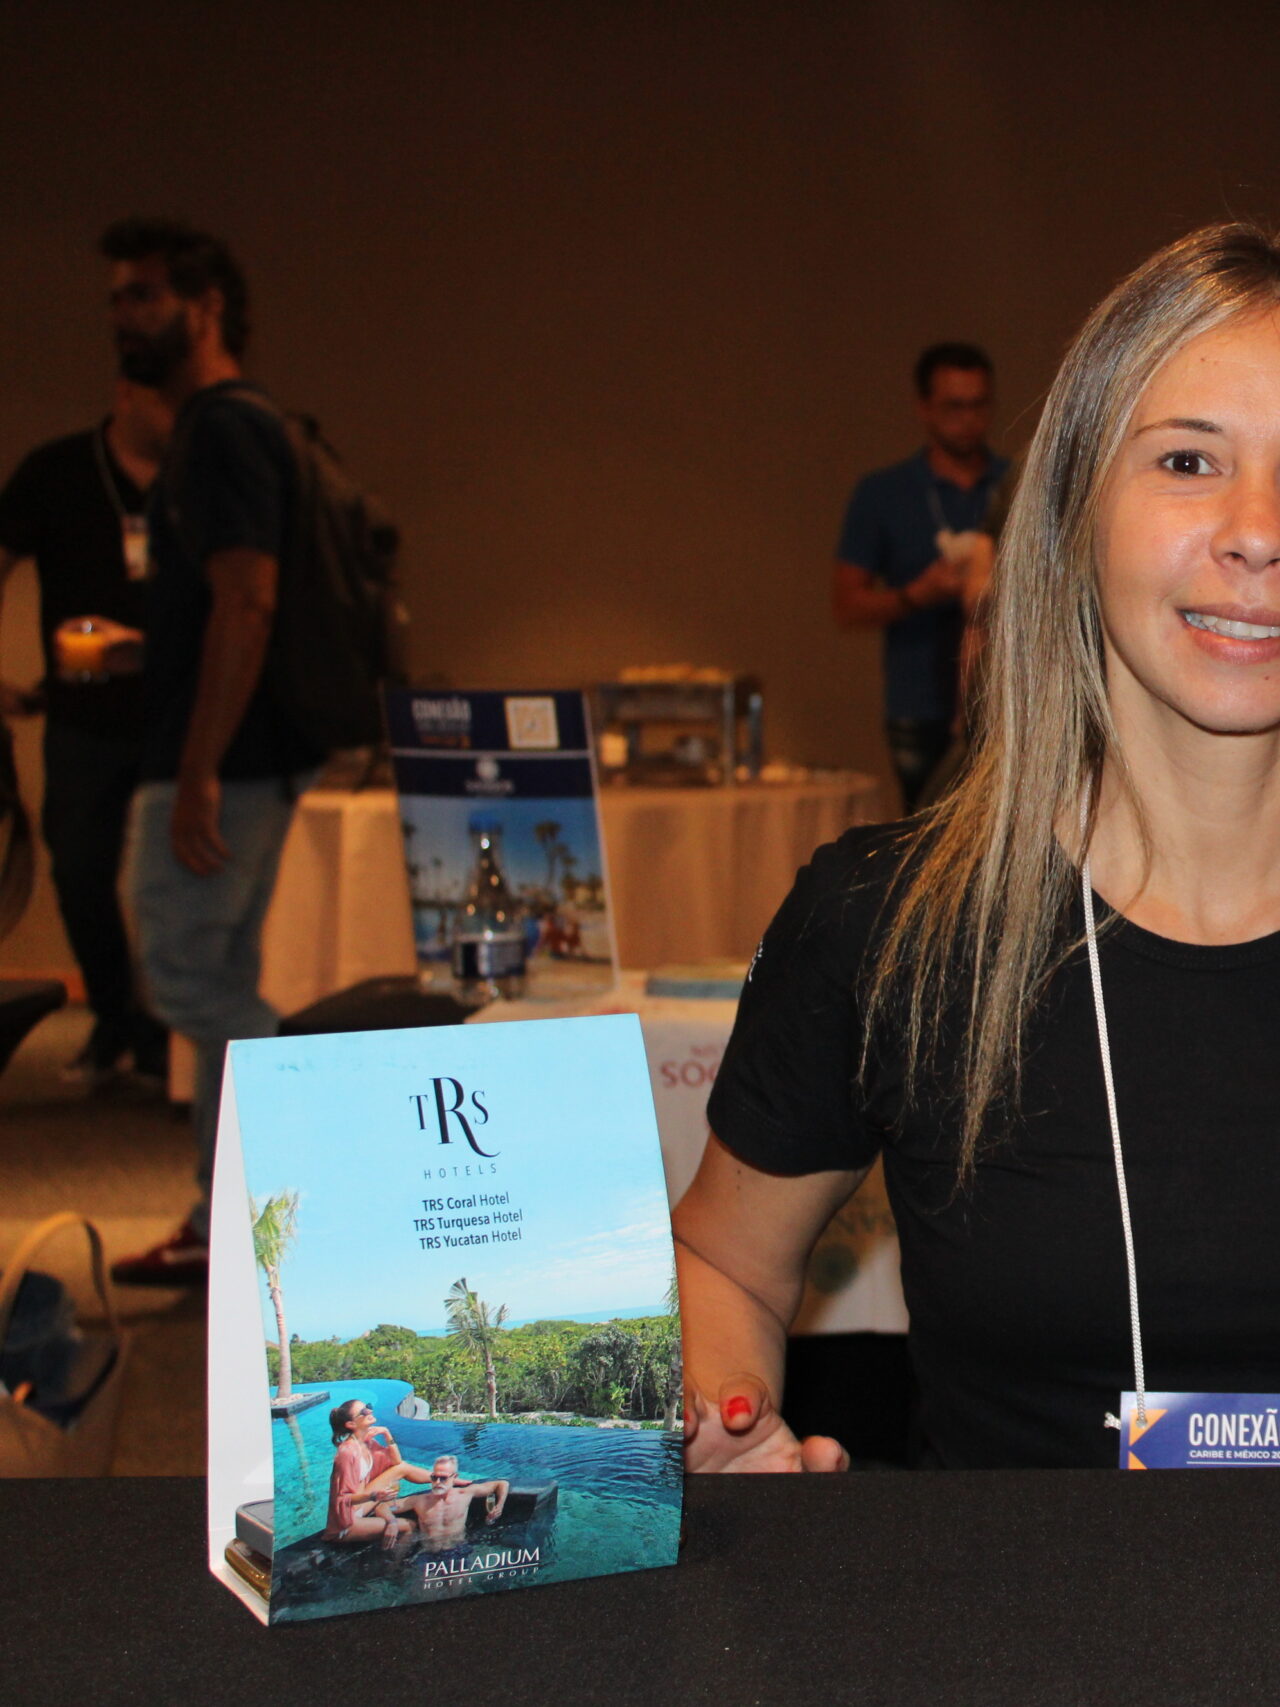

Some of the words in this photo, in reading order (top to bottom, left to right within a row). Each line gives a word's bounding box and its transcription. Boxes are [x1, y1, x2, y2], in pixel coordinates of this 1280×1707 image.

[409, 1076, 501, 1158] TRS
[424, 1163, 497, 1180] HOTELS
[422, 1198, 444, 1212] TRS
[447, 1194, 477, 1210] Coral
[480, 1191, 510, 1207] Hotel
[413, 1217, 435, 1232] TRS
[437, 1214, 490, 1231] Turquesa
[493, 1208, 523, 1224] Hotel
[419, 1236, 441, 1250] TRS
[443, 1233, 488, 1248] Yucatan
[491, 1227, 522, 1242] Hotel
[1189, 1450, 1224, 1459] CARIBE
[1226, 1450, 1232, 1459] E
[1234, 1449, 1270, 1459] MÉXICO
[425, 1547, 540, 1577] PALLADIUM
[423, 1577, 473, 1590] HOTEL
[486, 1567, 539, 1581] GROUP
